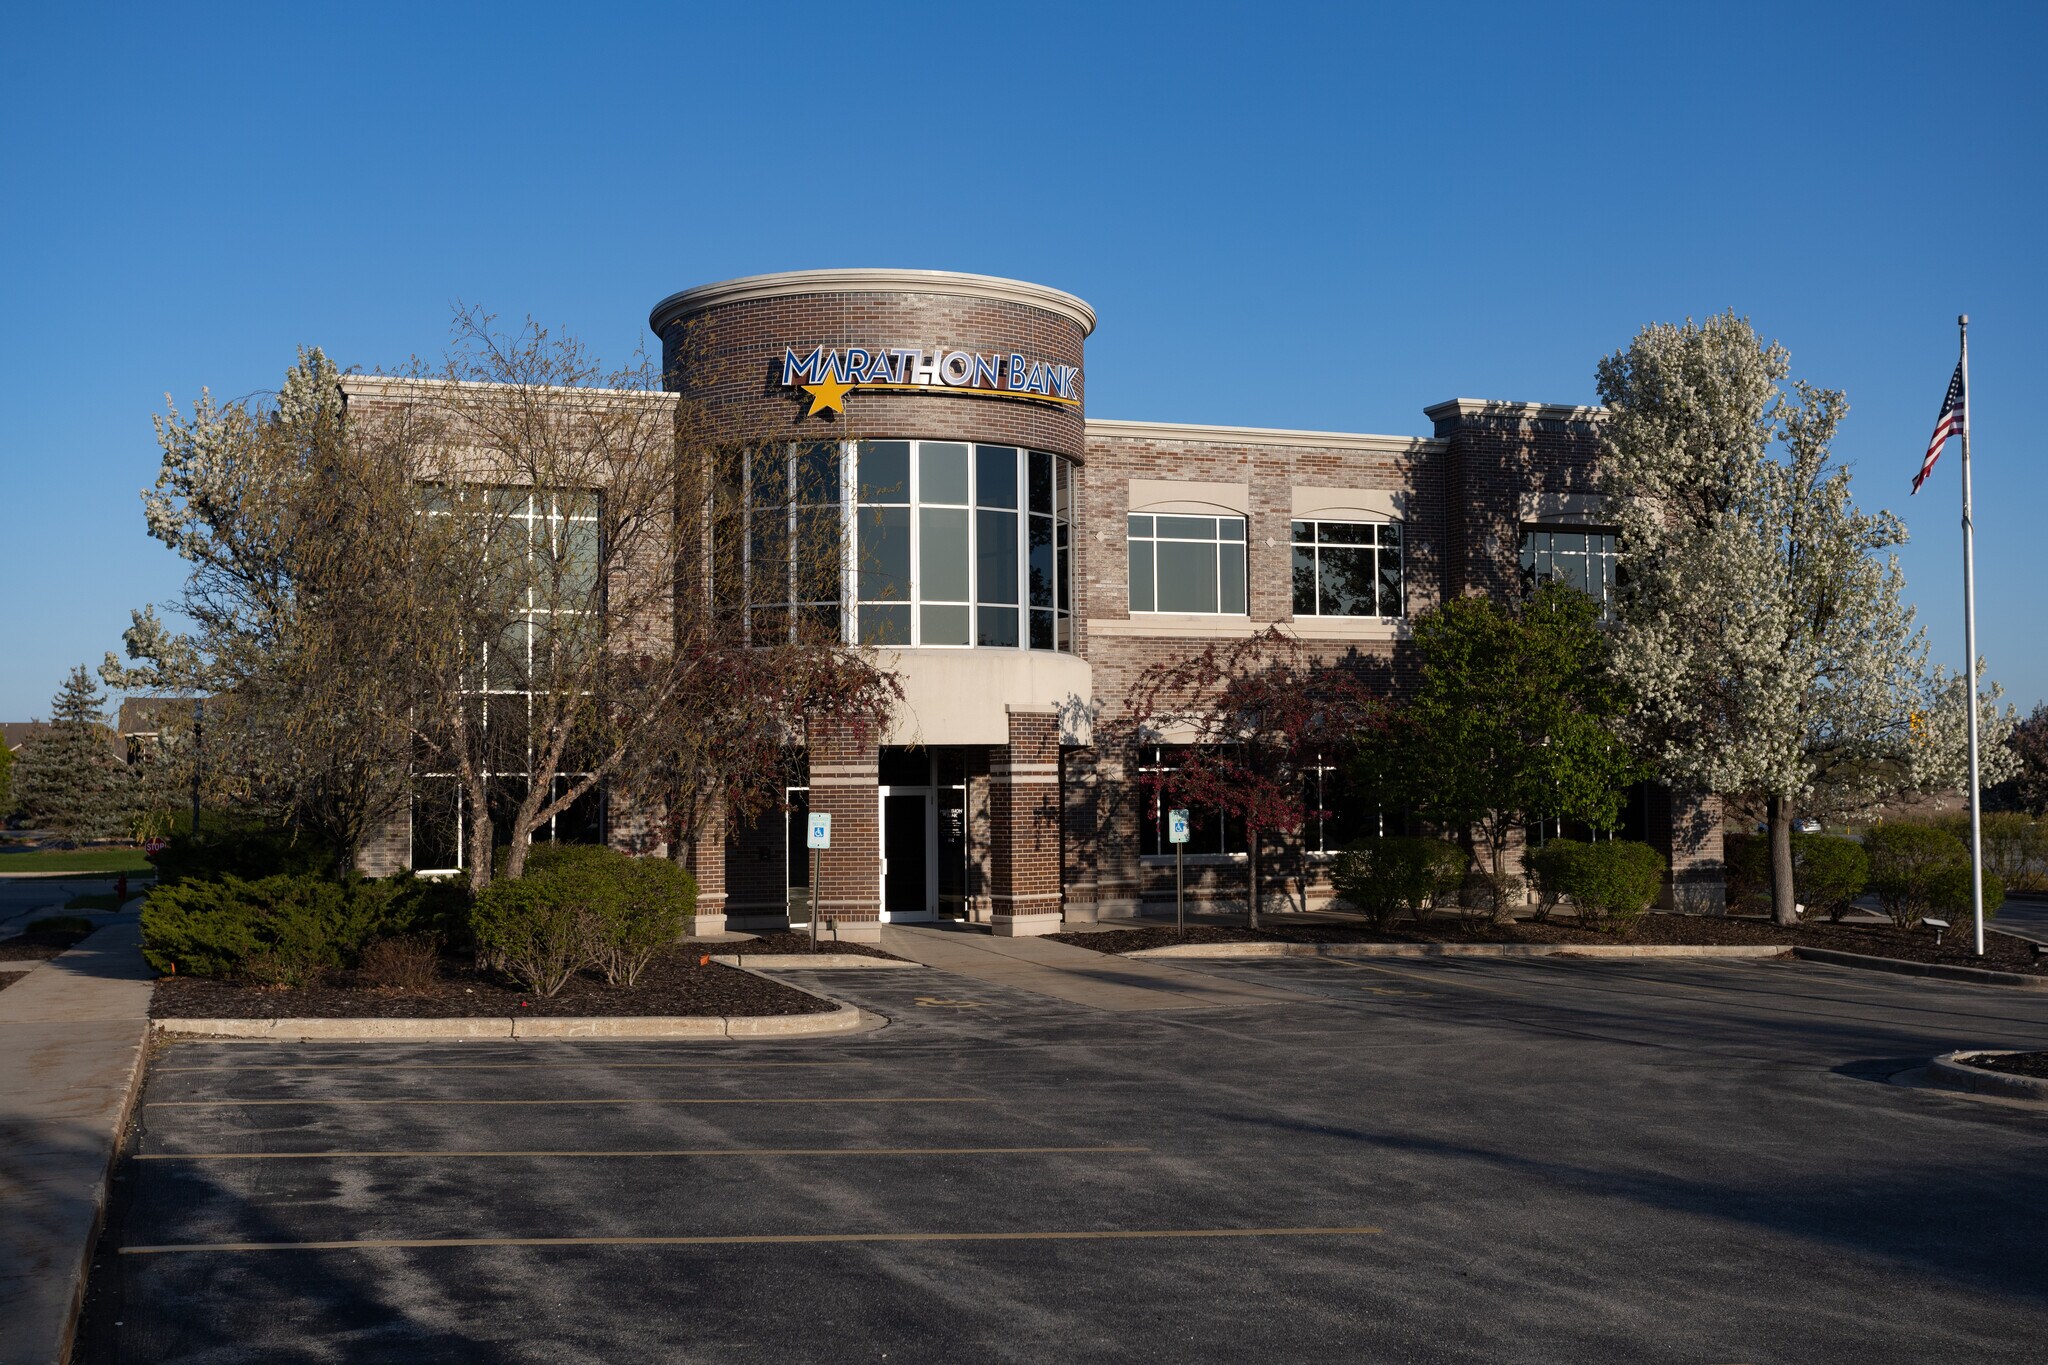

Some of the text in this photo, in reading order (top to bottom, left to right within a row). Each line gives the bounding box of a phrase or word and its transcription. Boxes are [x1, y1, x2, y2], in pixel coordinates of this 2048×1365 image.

[781, 344, 1080, 400] MARATHON BANK
[146, 843, 165, 852] STOP
